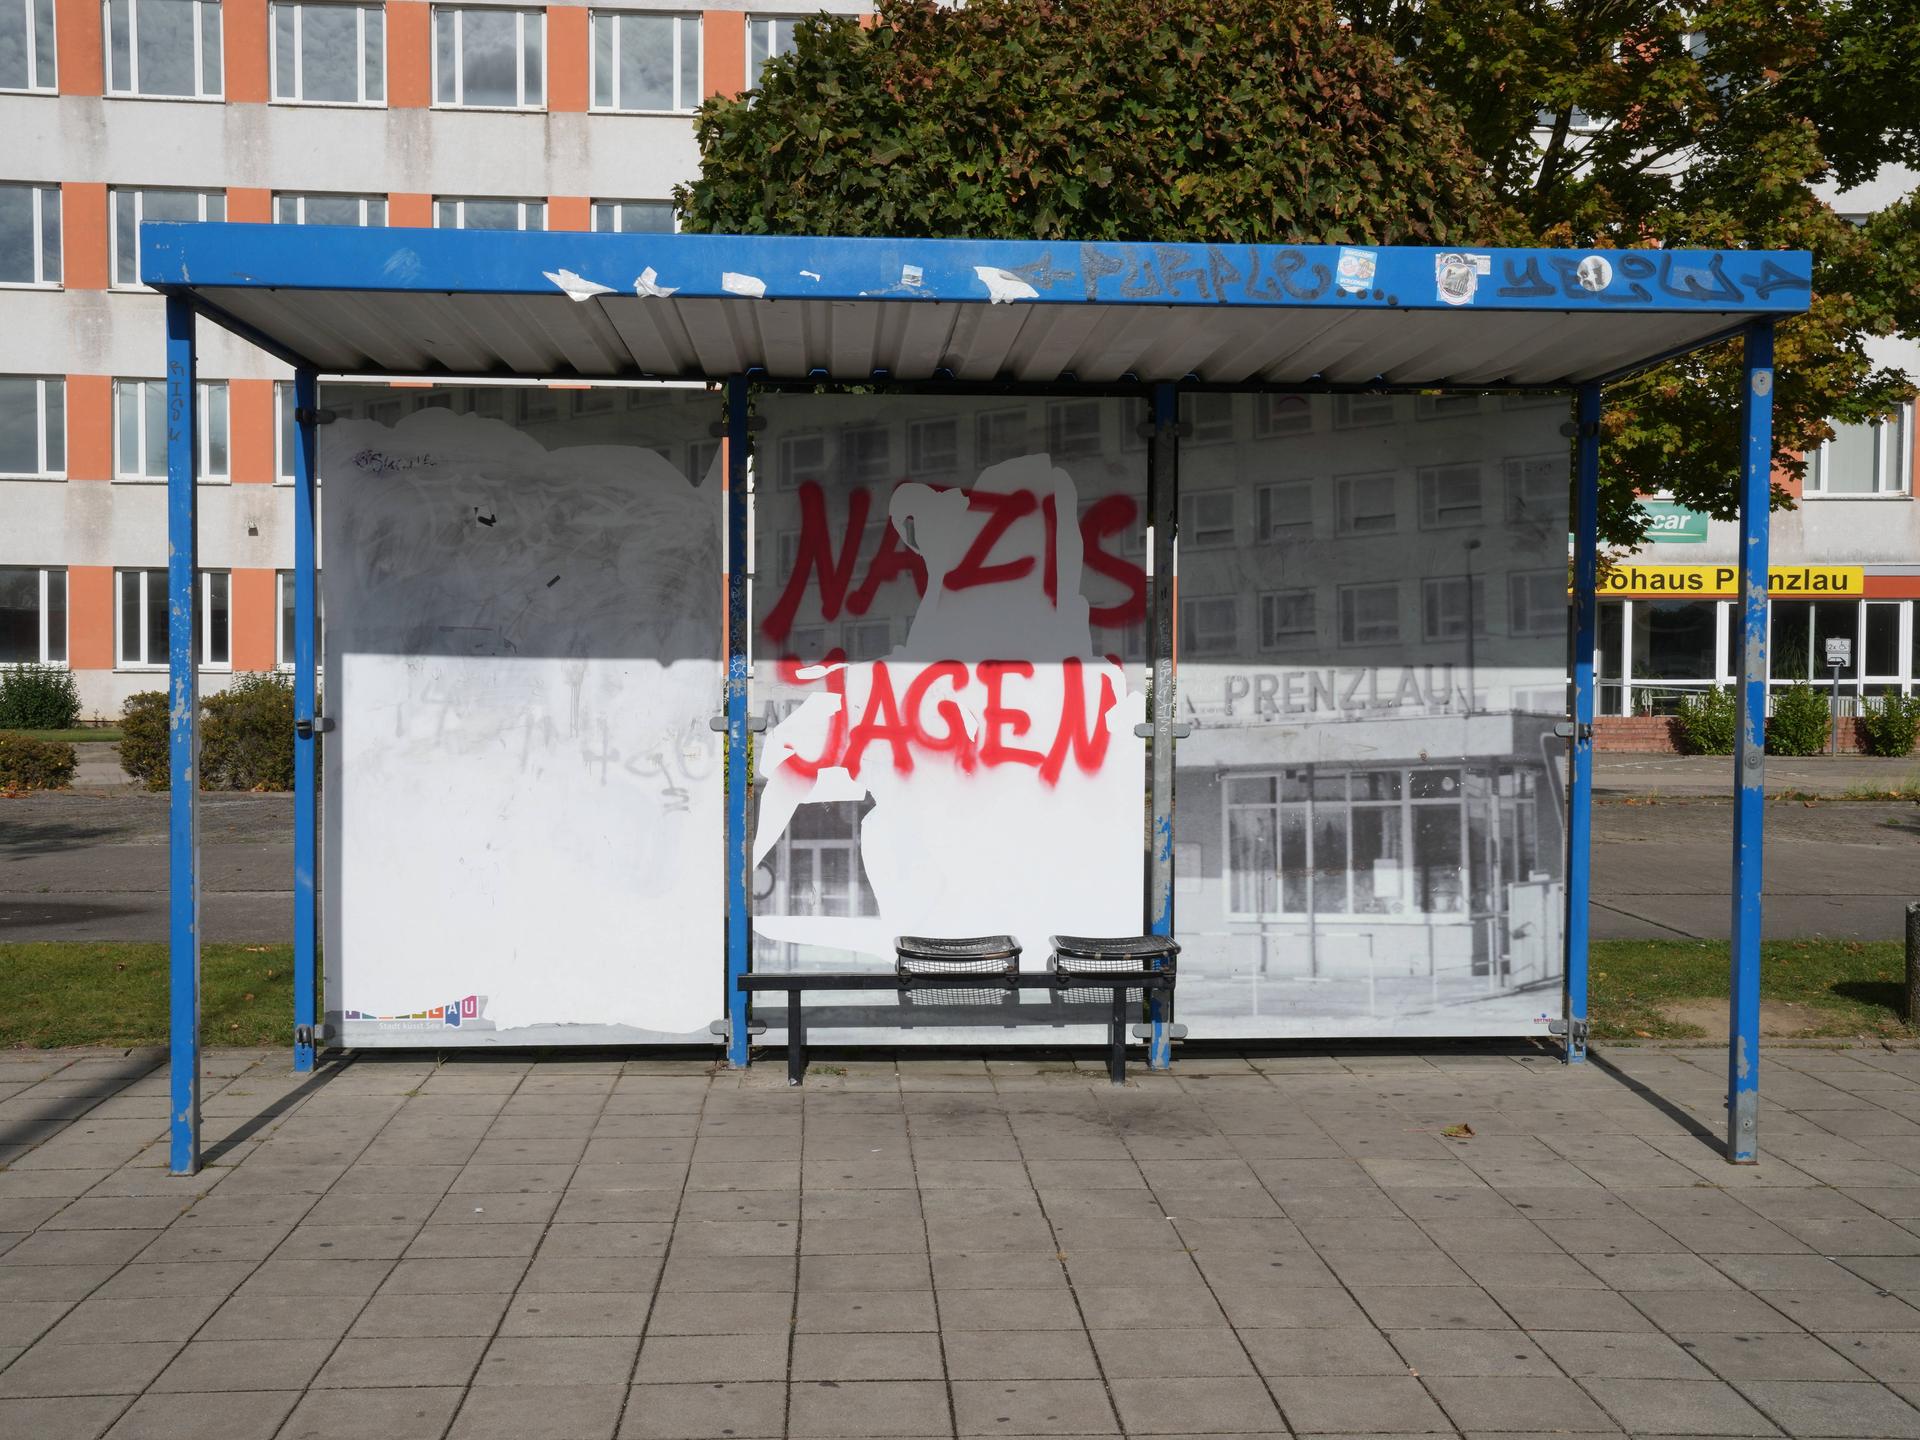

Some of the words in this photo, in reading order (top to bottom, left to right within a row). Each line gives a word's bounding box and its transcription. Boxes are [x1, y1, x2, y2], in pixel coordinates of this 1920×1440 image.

[760, 479, 1147, 645] NAZIS
[1716, 568, 1848, 590] Pnzlau
[776, 647, 1123, 789] JAGEN
[1223, 662, 1455, 717] PRENZLAU
